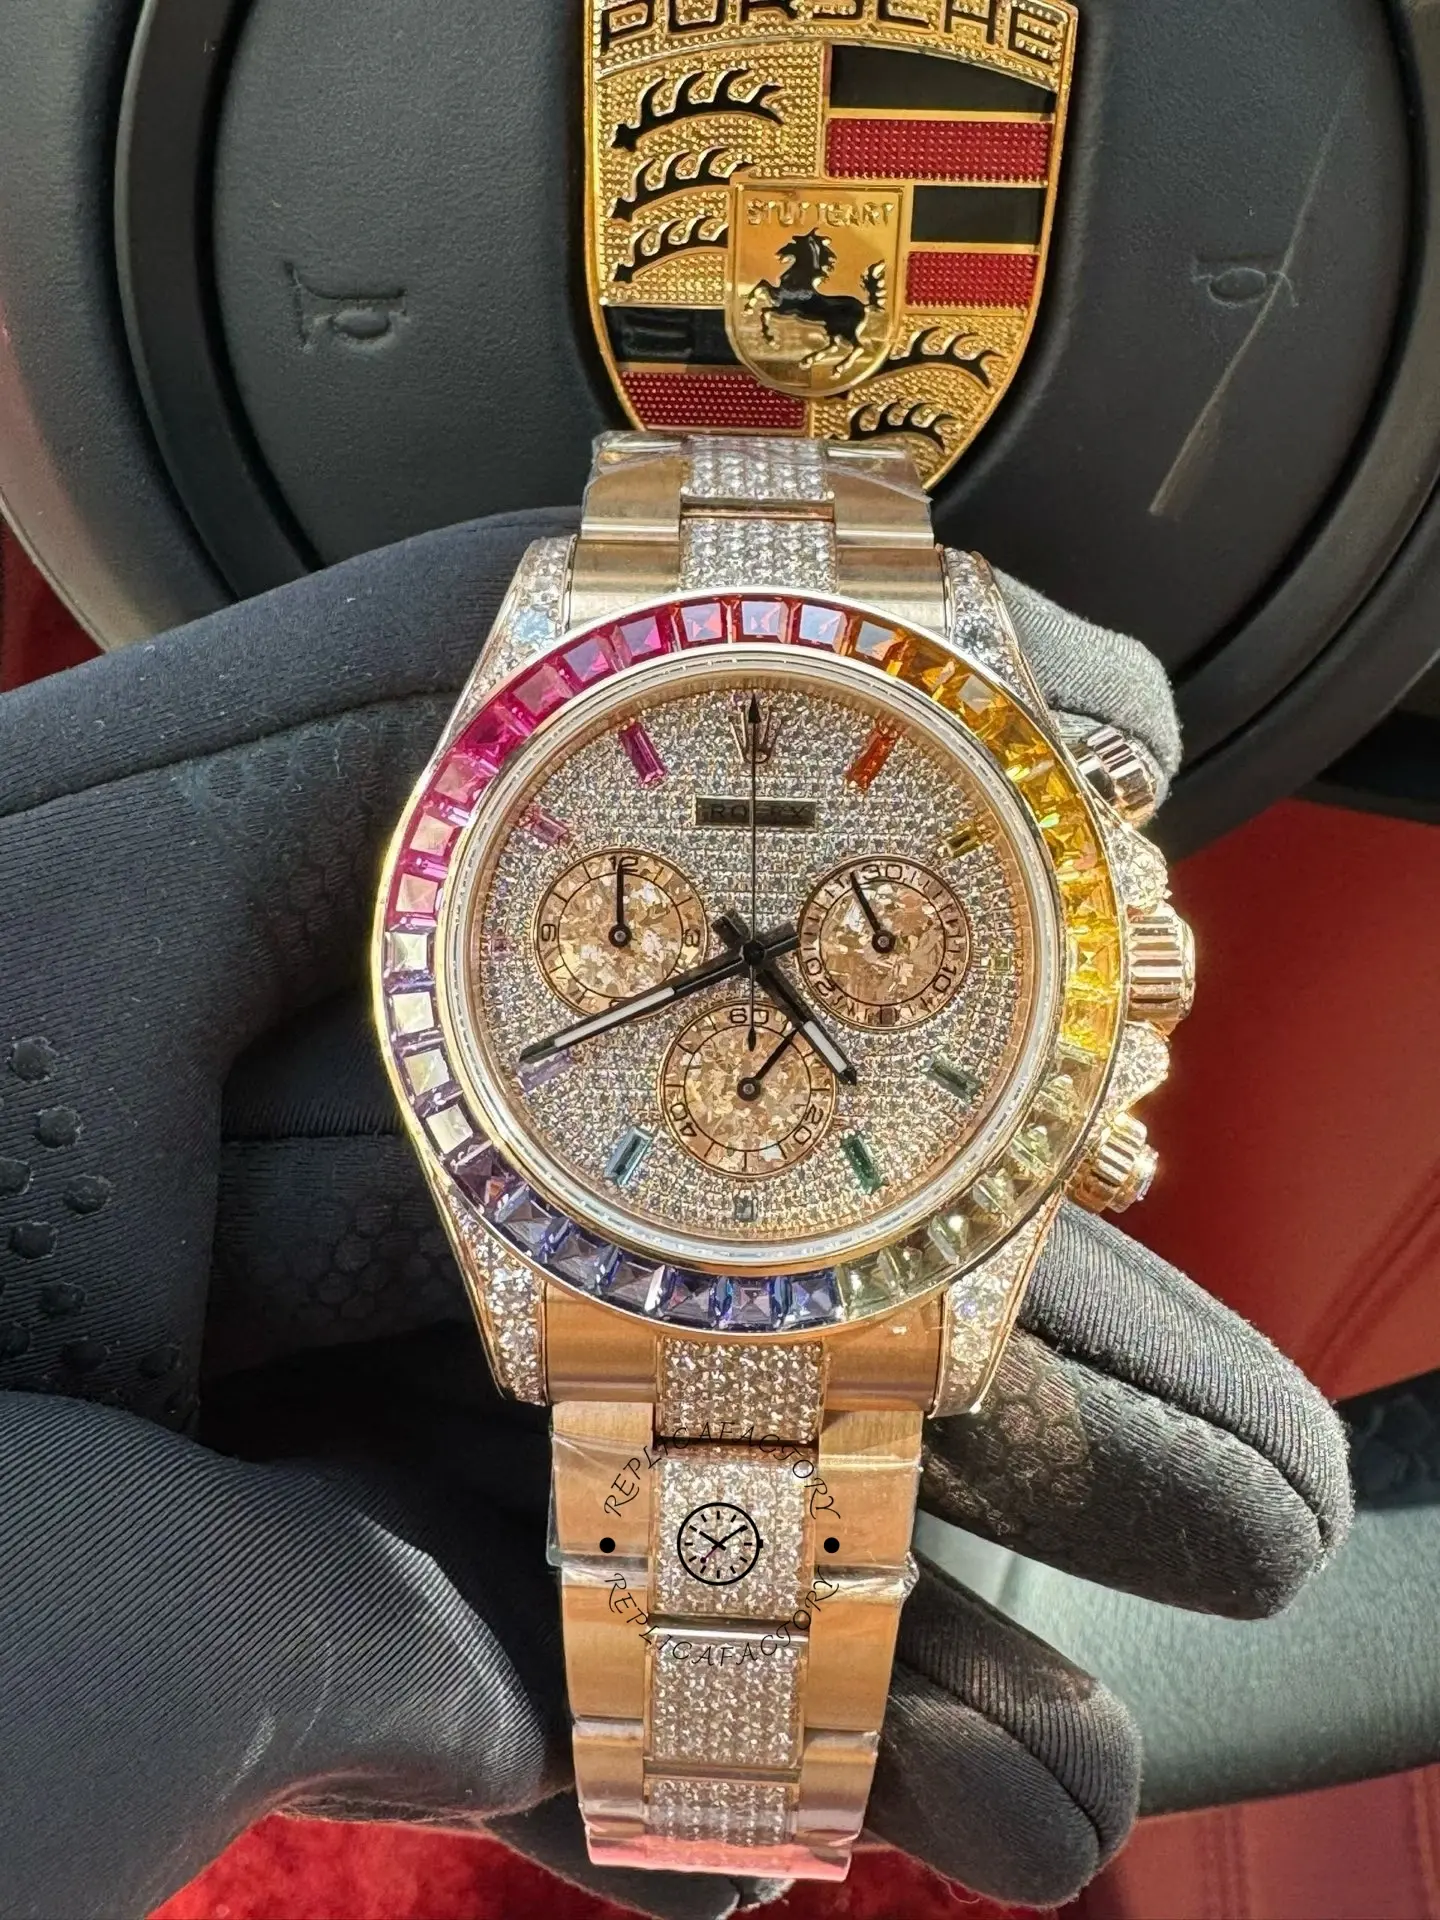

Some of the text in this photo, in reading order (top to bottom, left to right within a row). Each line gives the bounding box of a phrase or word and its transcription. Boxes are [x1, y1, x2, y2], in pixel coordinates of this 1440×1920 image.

[710, 803, 807, 819] ROEX
[608, 855, 639, 872] 12
[861, 863, 904, 881] 30
[803, 957, 835, 997] 20
[932, 964, 958, 994] 10
[729, 1007, 769, 1025] 60
[670, 1102, 698, 1137] 40
[792, 1104, 824, 1145] 20
